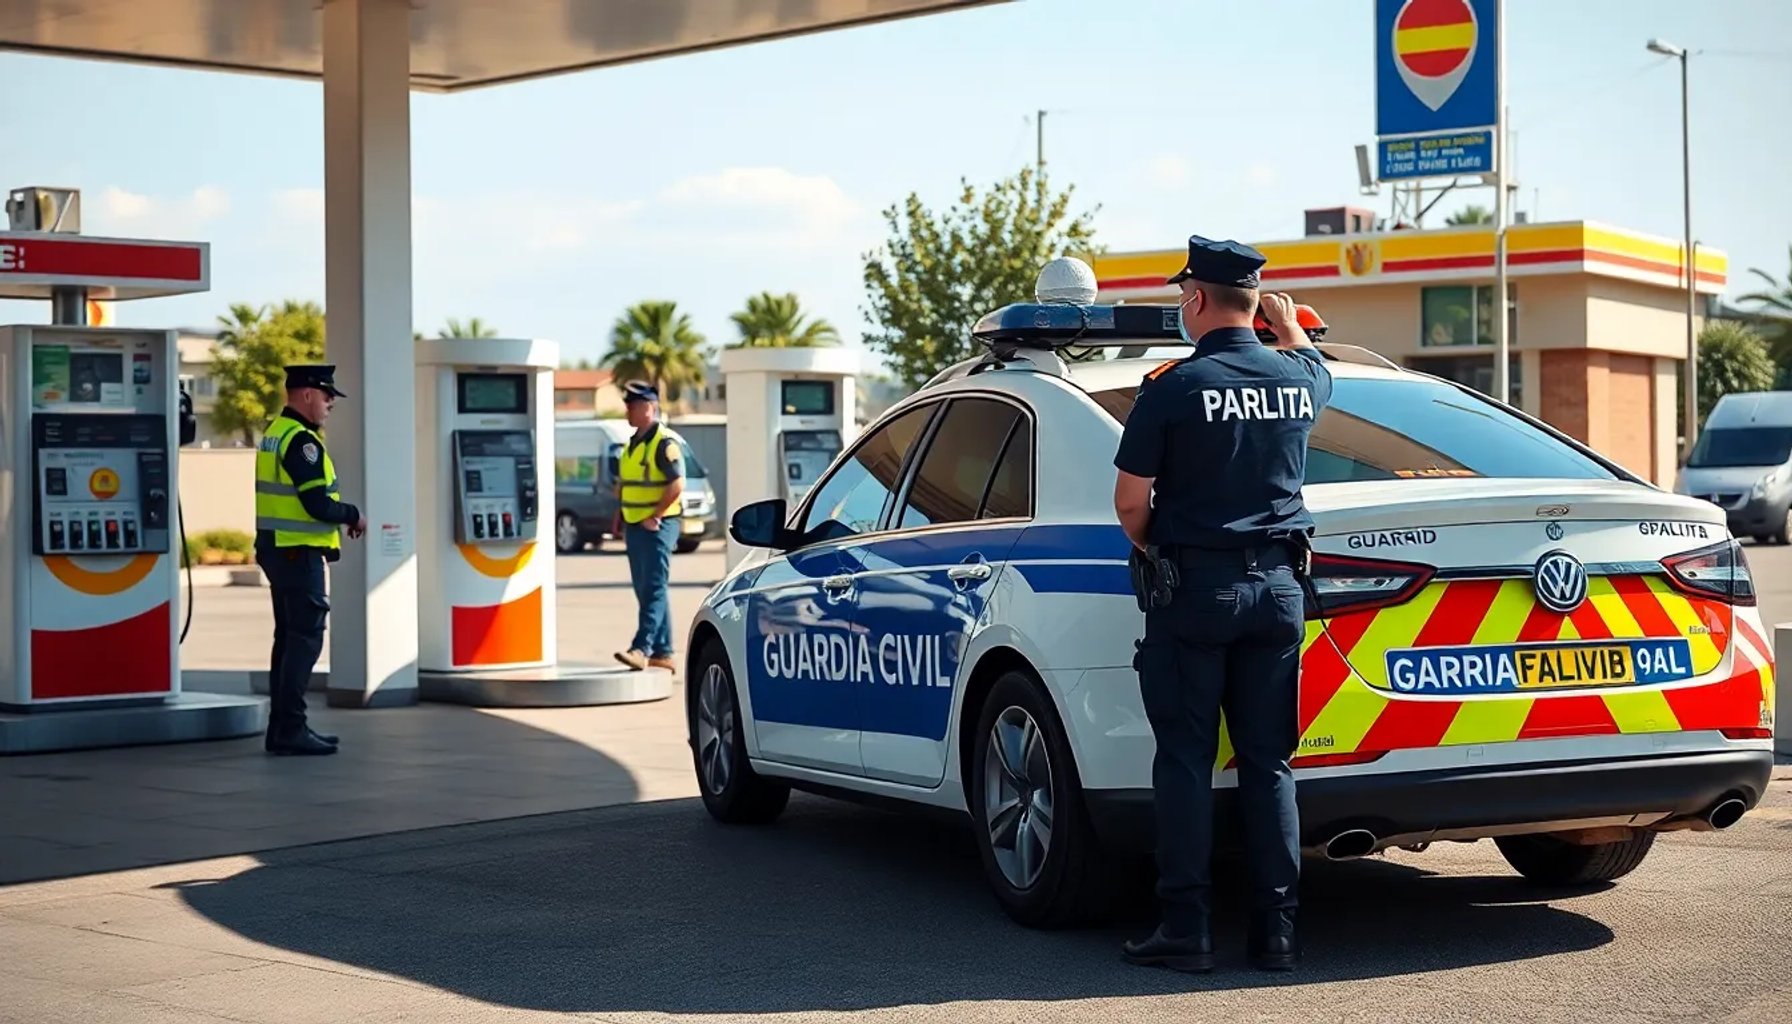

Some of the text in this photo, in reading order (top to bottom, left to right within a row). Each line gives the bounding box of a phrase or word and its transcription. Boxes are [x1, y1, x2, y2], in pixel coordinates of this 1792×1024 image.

[1202, 387, 1315, 421] PARLITA
[763, 633, 951, 687] GUARDIA CIVIL
[1393, 653, 1519, 691] GARRIA
